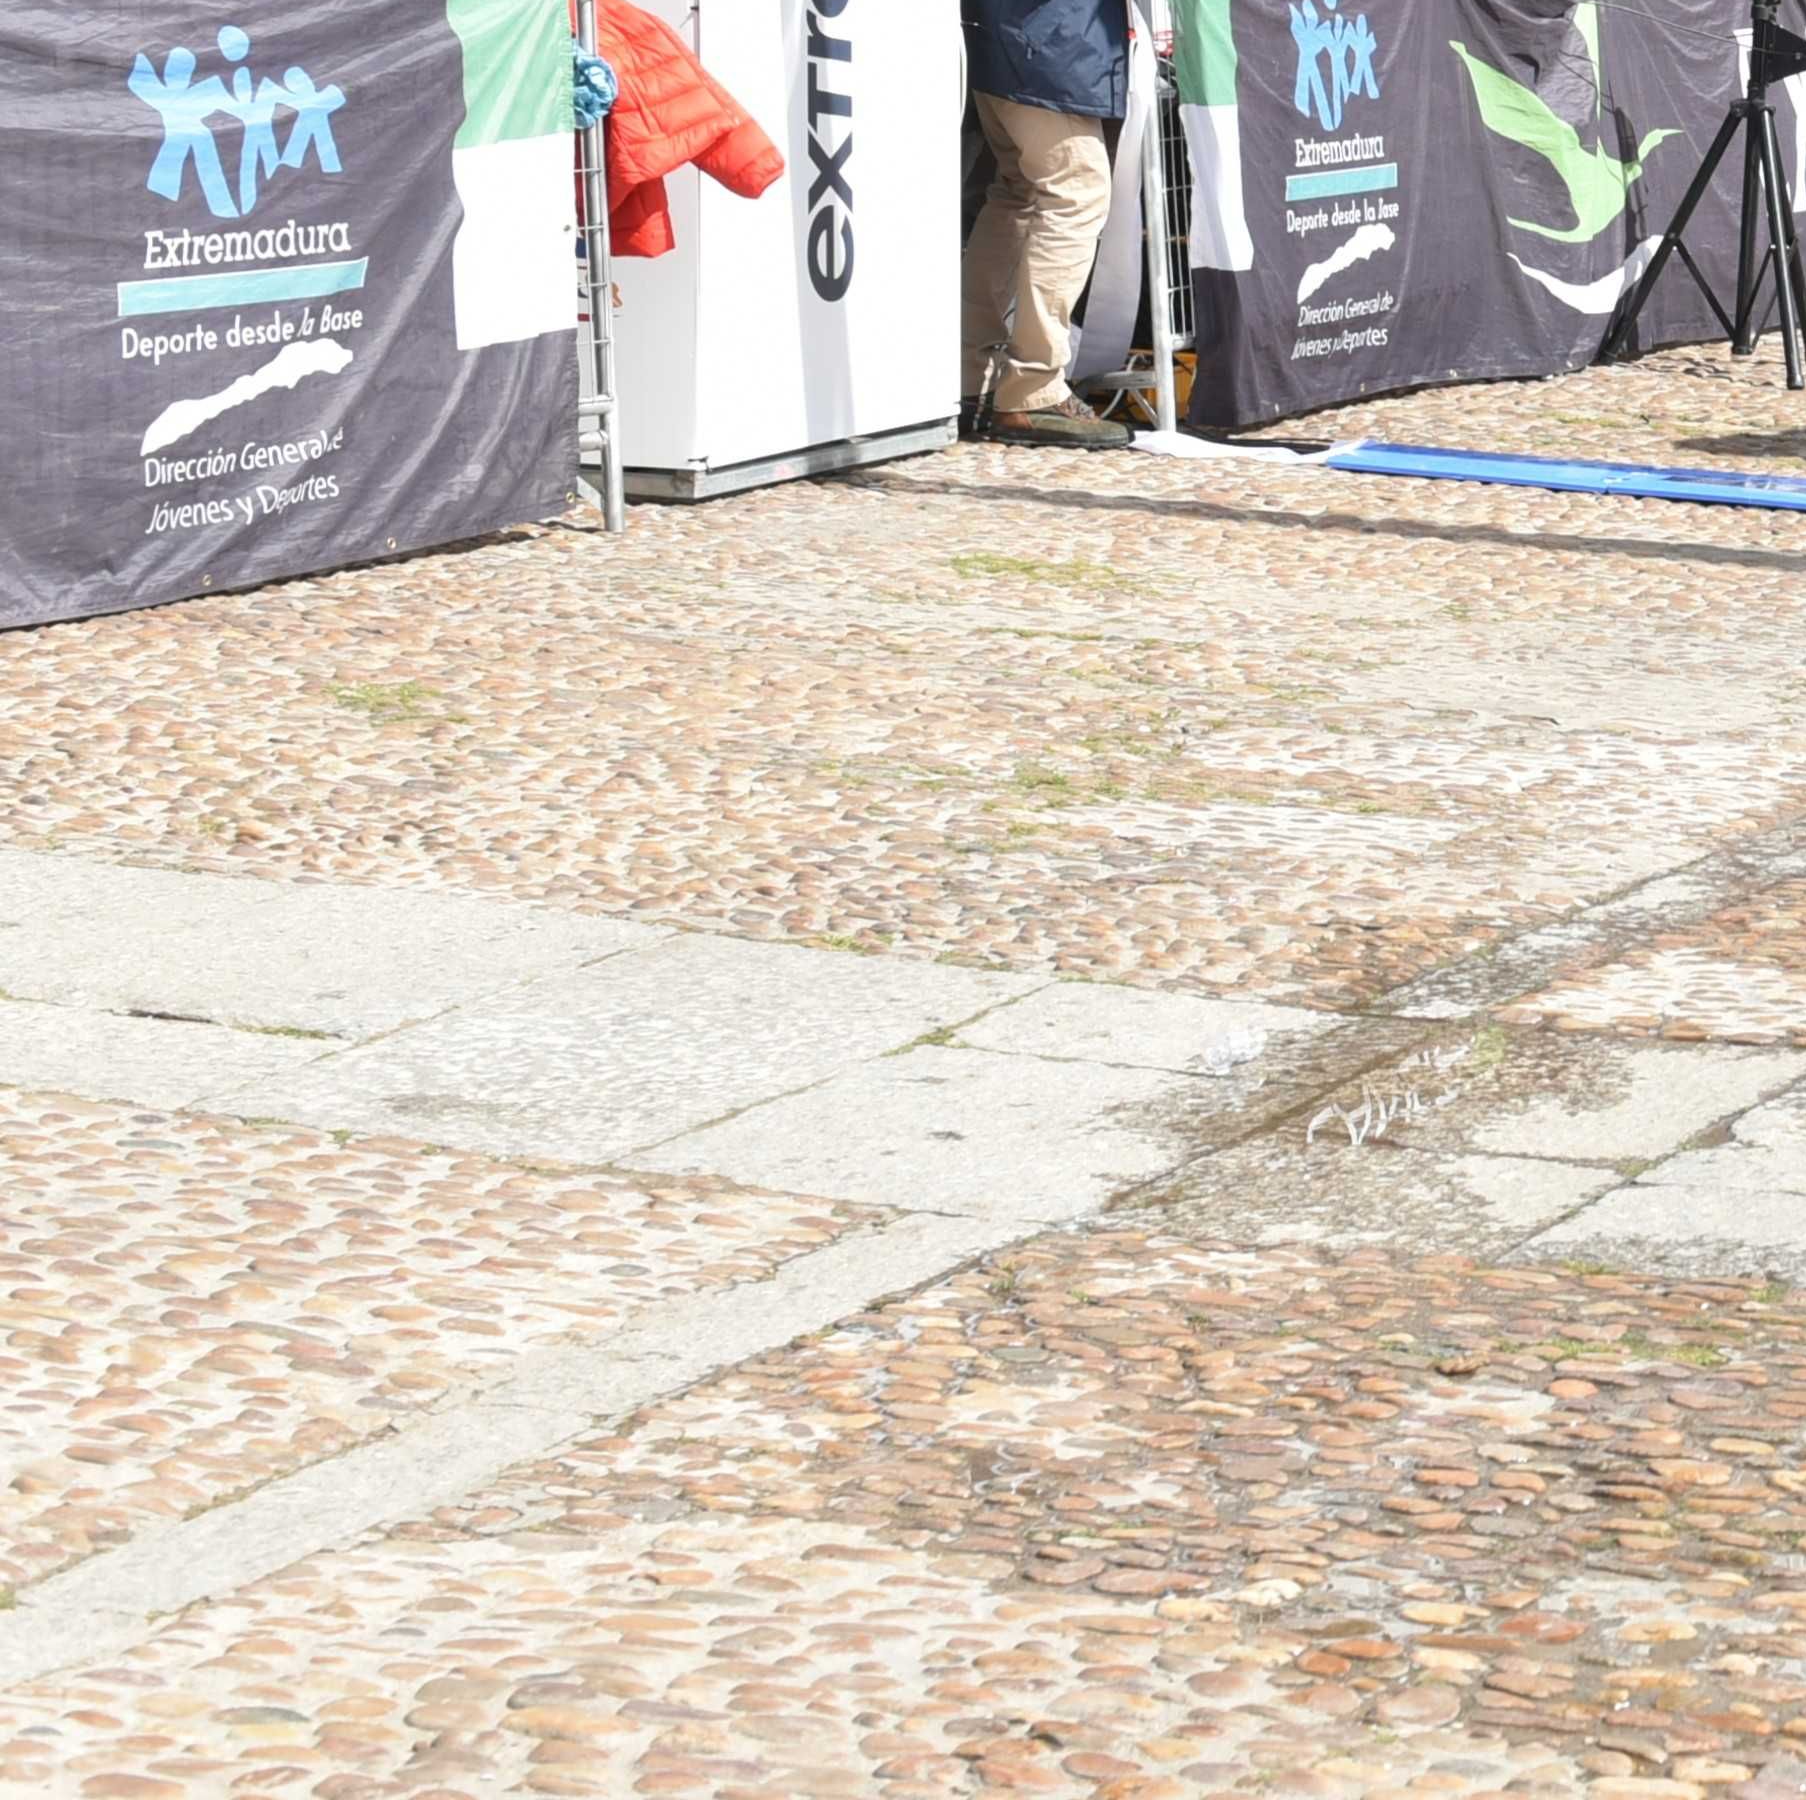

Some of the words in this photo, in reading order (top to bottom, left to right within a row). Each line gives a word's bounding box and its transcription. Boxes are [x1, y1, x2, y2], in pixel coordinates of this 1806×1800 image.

[1294, 132, 1385, 168] Extremadura
[1286, 207, 1329, 238] Deporte
[1331, 201, 1361, 227] desde
[143, 220, 351, 271] Extremadura
[121, 321, 218, 367] Deporte
[226, 311, 295, 349] desde
[319, 304, 364, 336] Base
[143, 451, 237, 489] Dirección
[145, 499, 234, 535] Jóvenes
[236, 500, 255, 526] y
